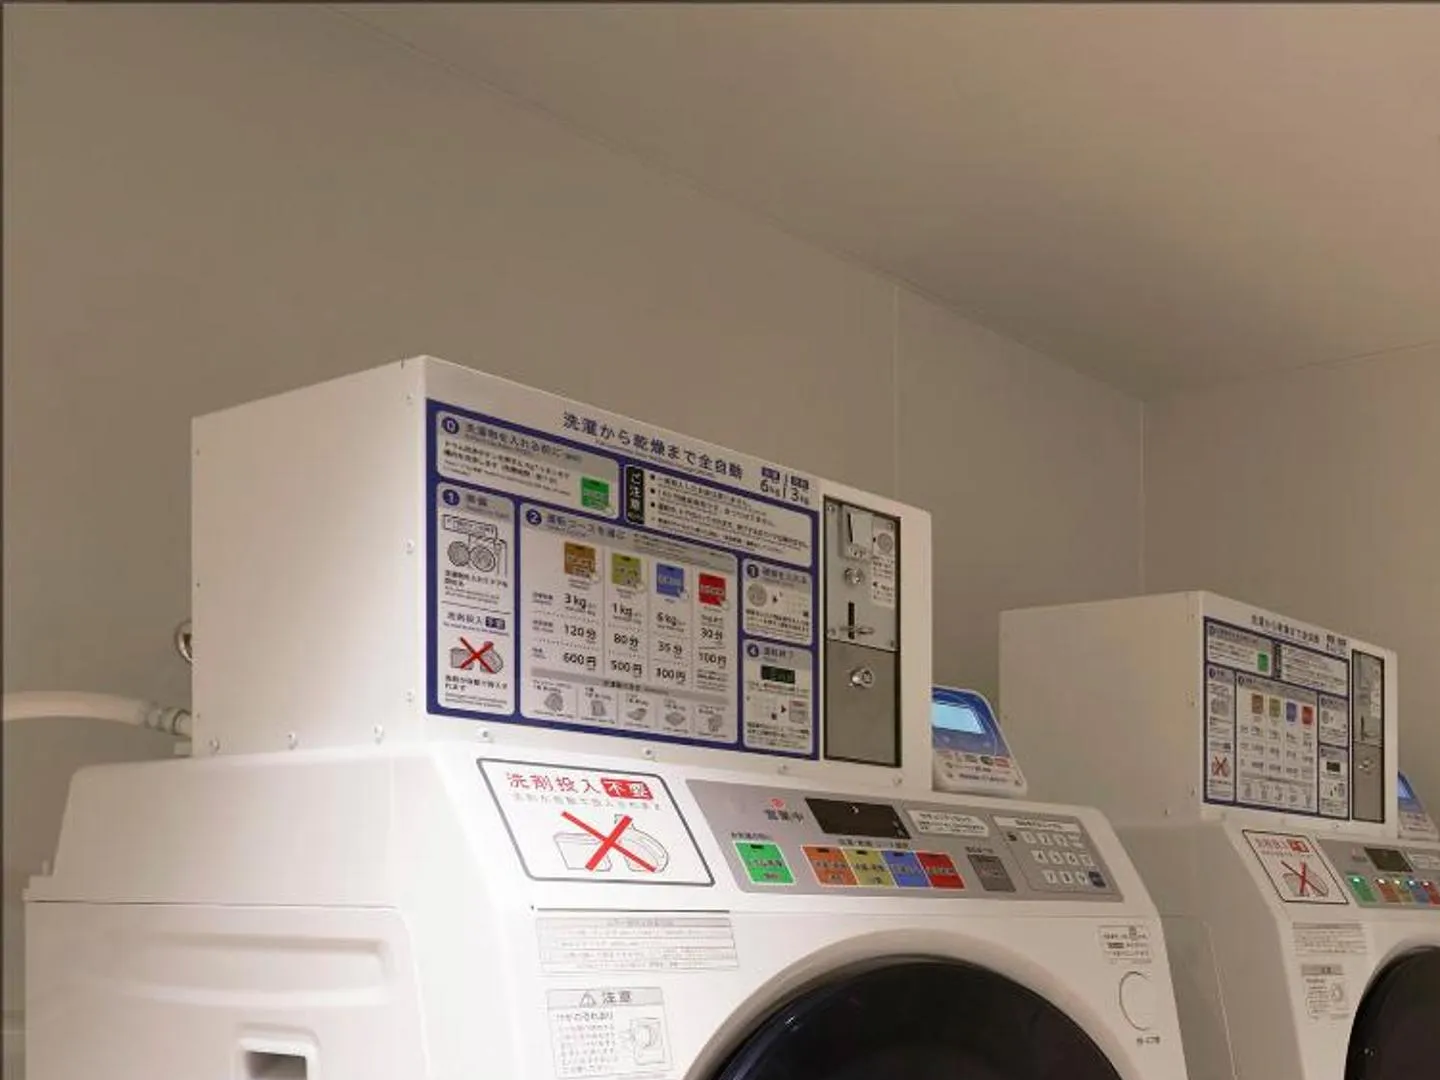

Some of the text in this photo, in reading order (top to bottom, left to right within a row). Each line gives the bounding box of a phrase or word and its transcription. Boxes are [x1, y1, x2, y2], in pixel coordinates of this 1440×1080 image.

[563, 411, 744, 481] 洗濯から乾燥まで全自動
[564, 625, 596, 640] 120分
[614, 634, 639, 648] 80分
[507, 772, 651, 797] 洗剤投入 不要
[602, 990, 632, 1005] 注意
